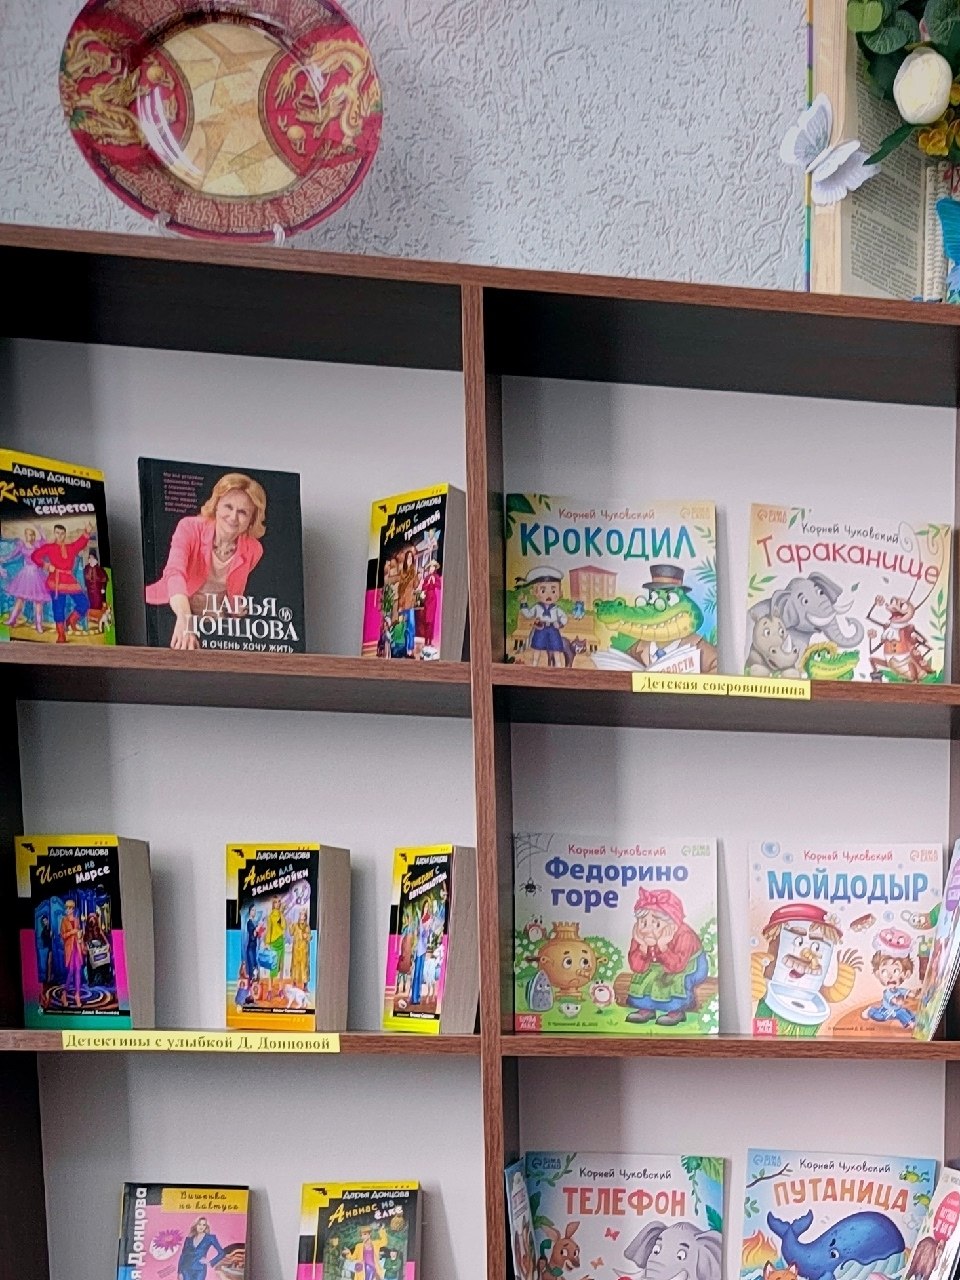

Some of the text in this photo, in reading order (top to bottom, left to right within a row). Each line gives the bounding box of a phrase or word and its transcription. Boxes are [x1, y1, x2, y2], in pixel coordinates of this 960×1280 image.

[13, 464, 91, 489] Дарья Донцова
[0, 480, 66, 503] Кладбище
[23, 497, 60, 508] чужих
[35, 503, 95, 516] секретов
[559, 507, 656, 523] Корней Чуковский
[404, 510, 441, 541] гранатой
[802, 522, 899, 544] Корней Чуковский
[520, 523, 696, 561] КРОКОДИЛ
[757, 535, 941, 585] Тараканище
[202, 593, 277, 617] ДАРЬЯ
[183, 614, 300, 641] ДОНЦОВА
[202, 640, 294, 653] Я ОЧЕНЬ ХОЧУ ЖИТЬ
[641, 676, 806, 697] Детская сокровищница
[49, 847, 109, 857] Дарья Донцова
[568, 843, 667, 857] Корней Чуковский
[804, 849, 893, 863] Корней Чуковский
[36, 860, 96, 885] Ипотека на
[75, 865, 110, 884] Марсе
[243, 863, 293, 891] Алиби для
[251, 868, 309, 897] землеройки
[545, 857, 689, 887] Федорино
[767, 868, 929, 904] МОЙДОДЫР
[551, 888, 619, 913] горе
[66, 1034, 331, 1050] Детективы с улыбкой Д. Донцовой
[579, 1166, 672, 1181] Корней Чуковский
[799, 1159, 891, 1174] Корней Чуковский
[181, 1190, 227, 1200] Вишенка
[195, 1201, 240, 1212] кактусе
[343, 1190, 410, 1200] Дарья Донцова
[563, 1187, 686, 1216] ТЕЛЕФОН
[773, 1177, 910, 1213] ПУТАНИЦА
[328, 1200, 394, 1228] Ананас на
[128, 1187, 148, 1267] Донцова
